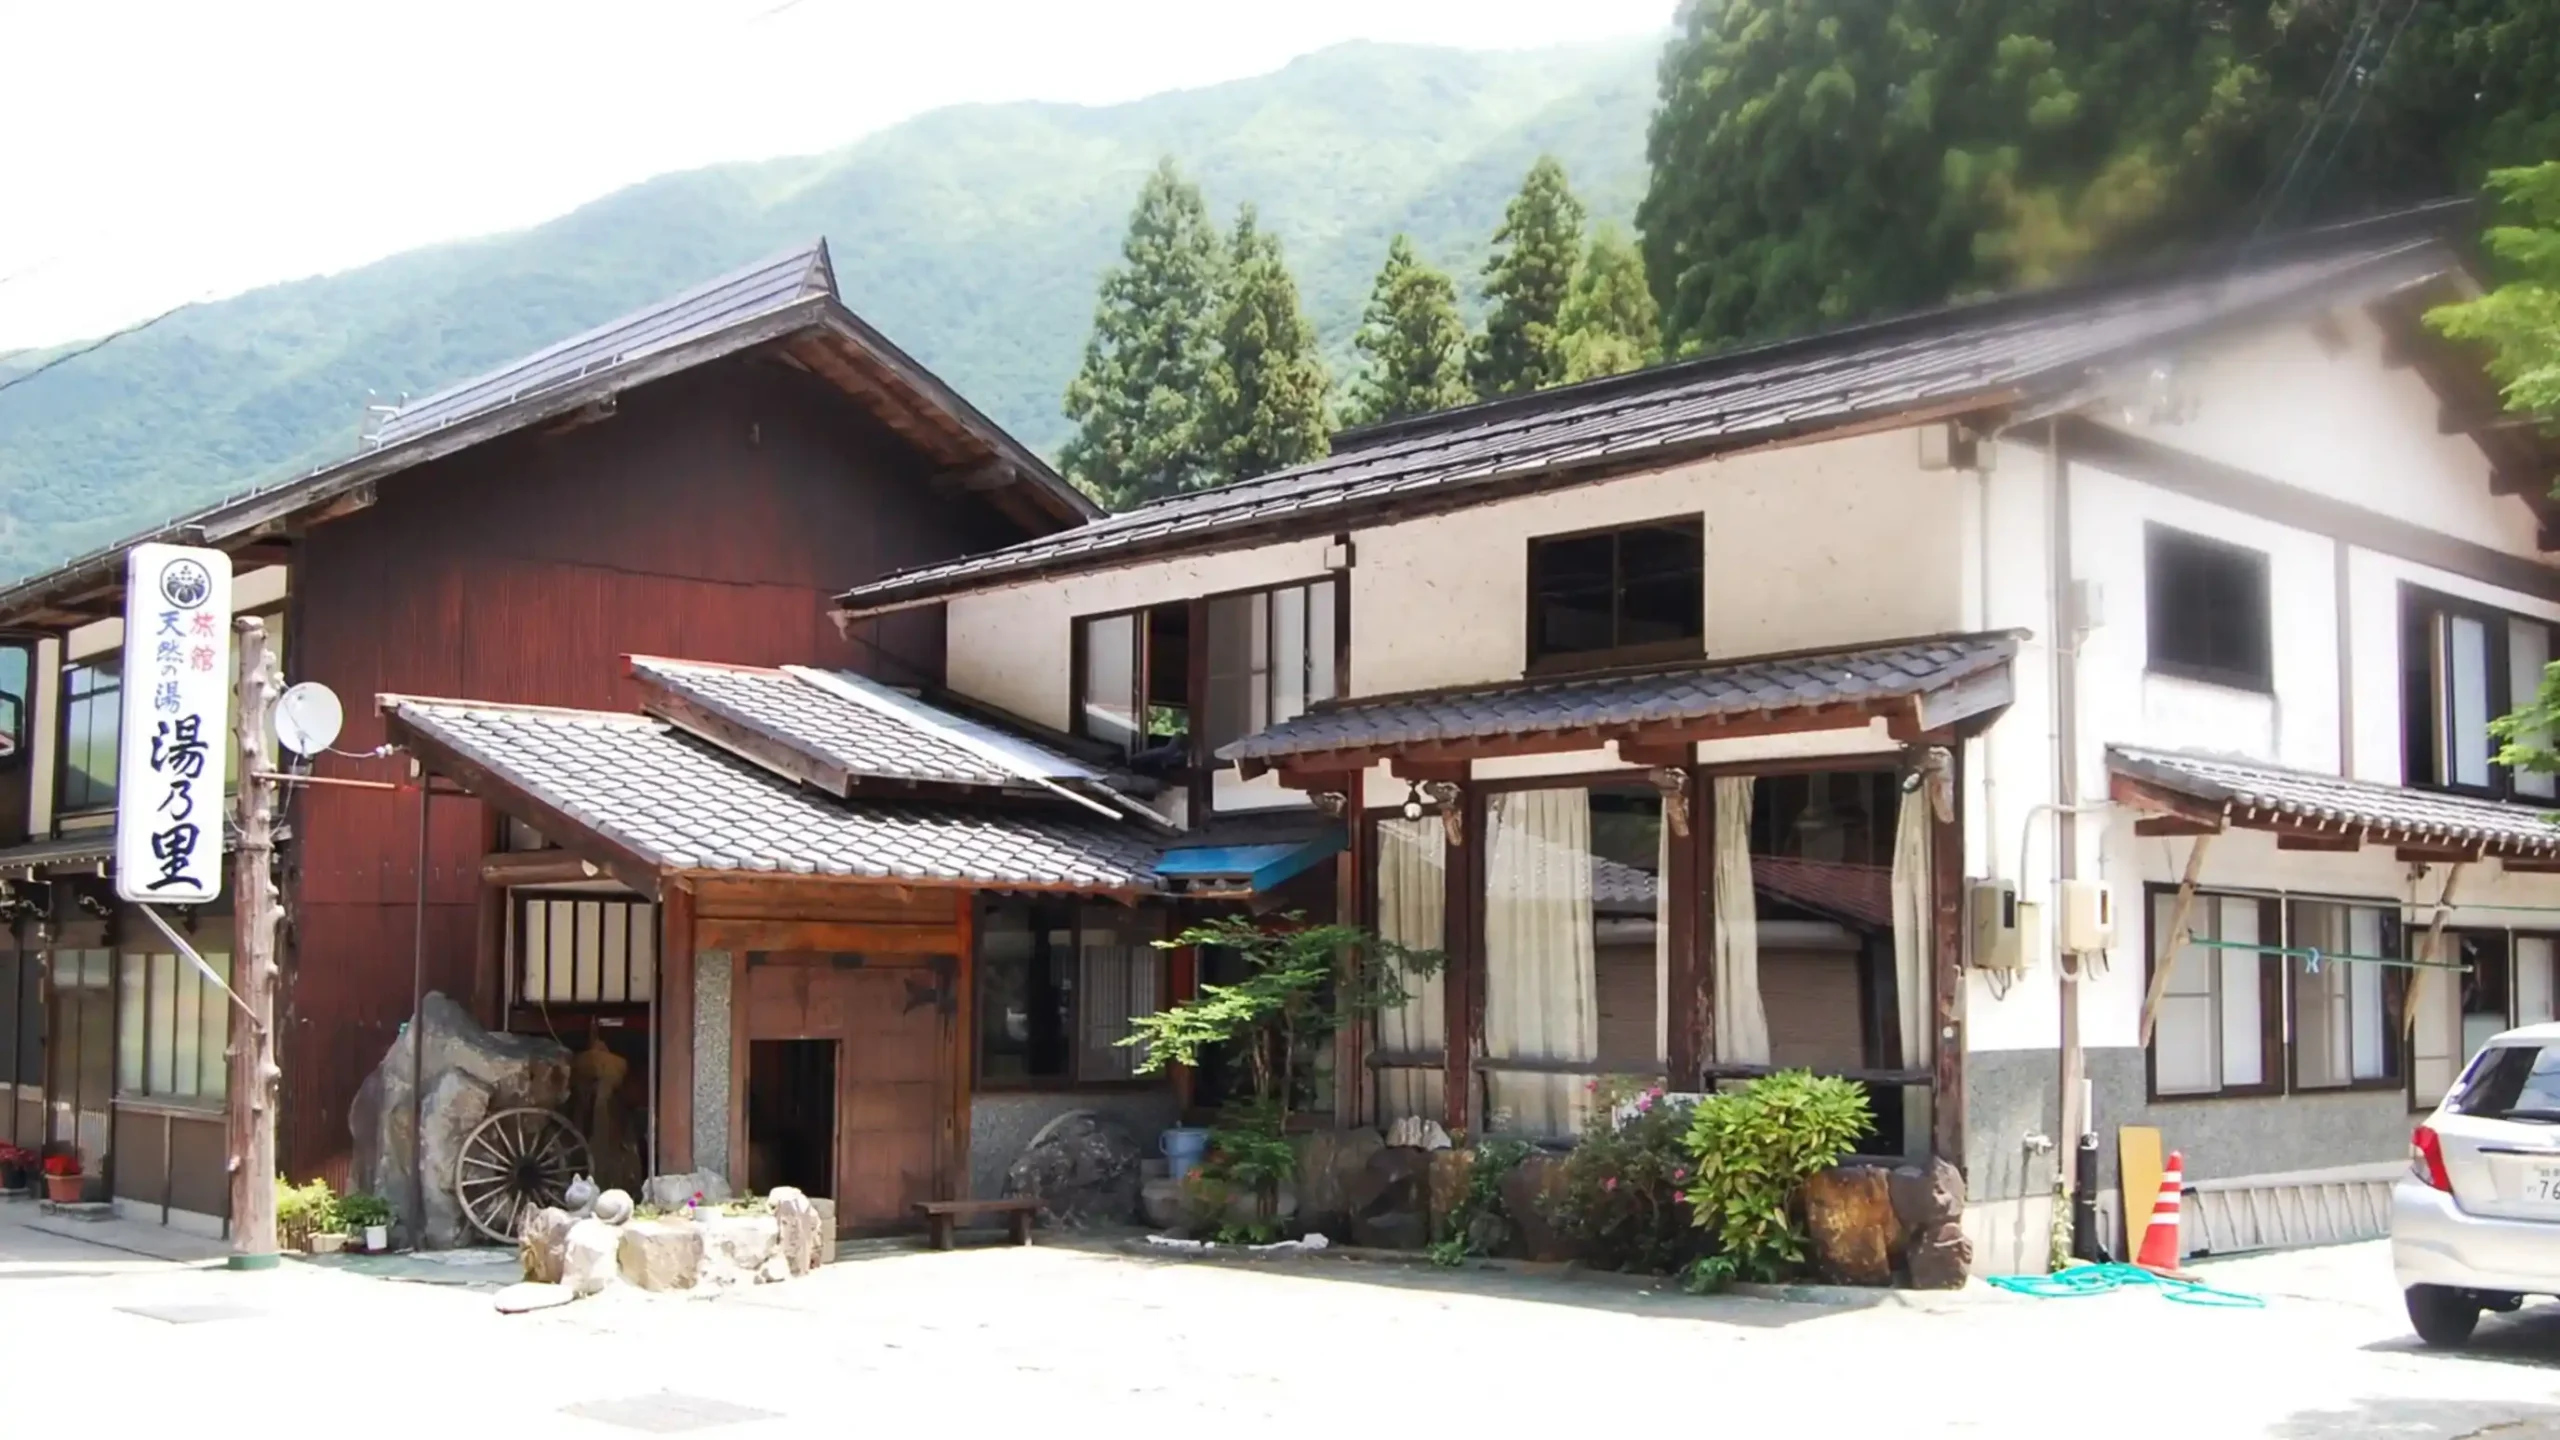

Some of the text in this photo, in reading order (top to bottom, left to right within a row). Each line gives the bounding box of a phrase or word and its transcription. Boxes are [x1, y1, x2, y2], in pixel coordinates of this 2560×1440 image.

[155, 610, 187, 714] 天然の湯
[146, 713, 209, 891] 湯乃里
